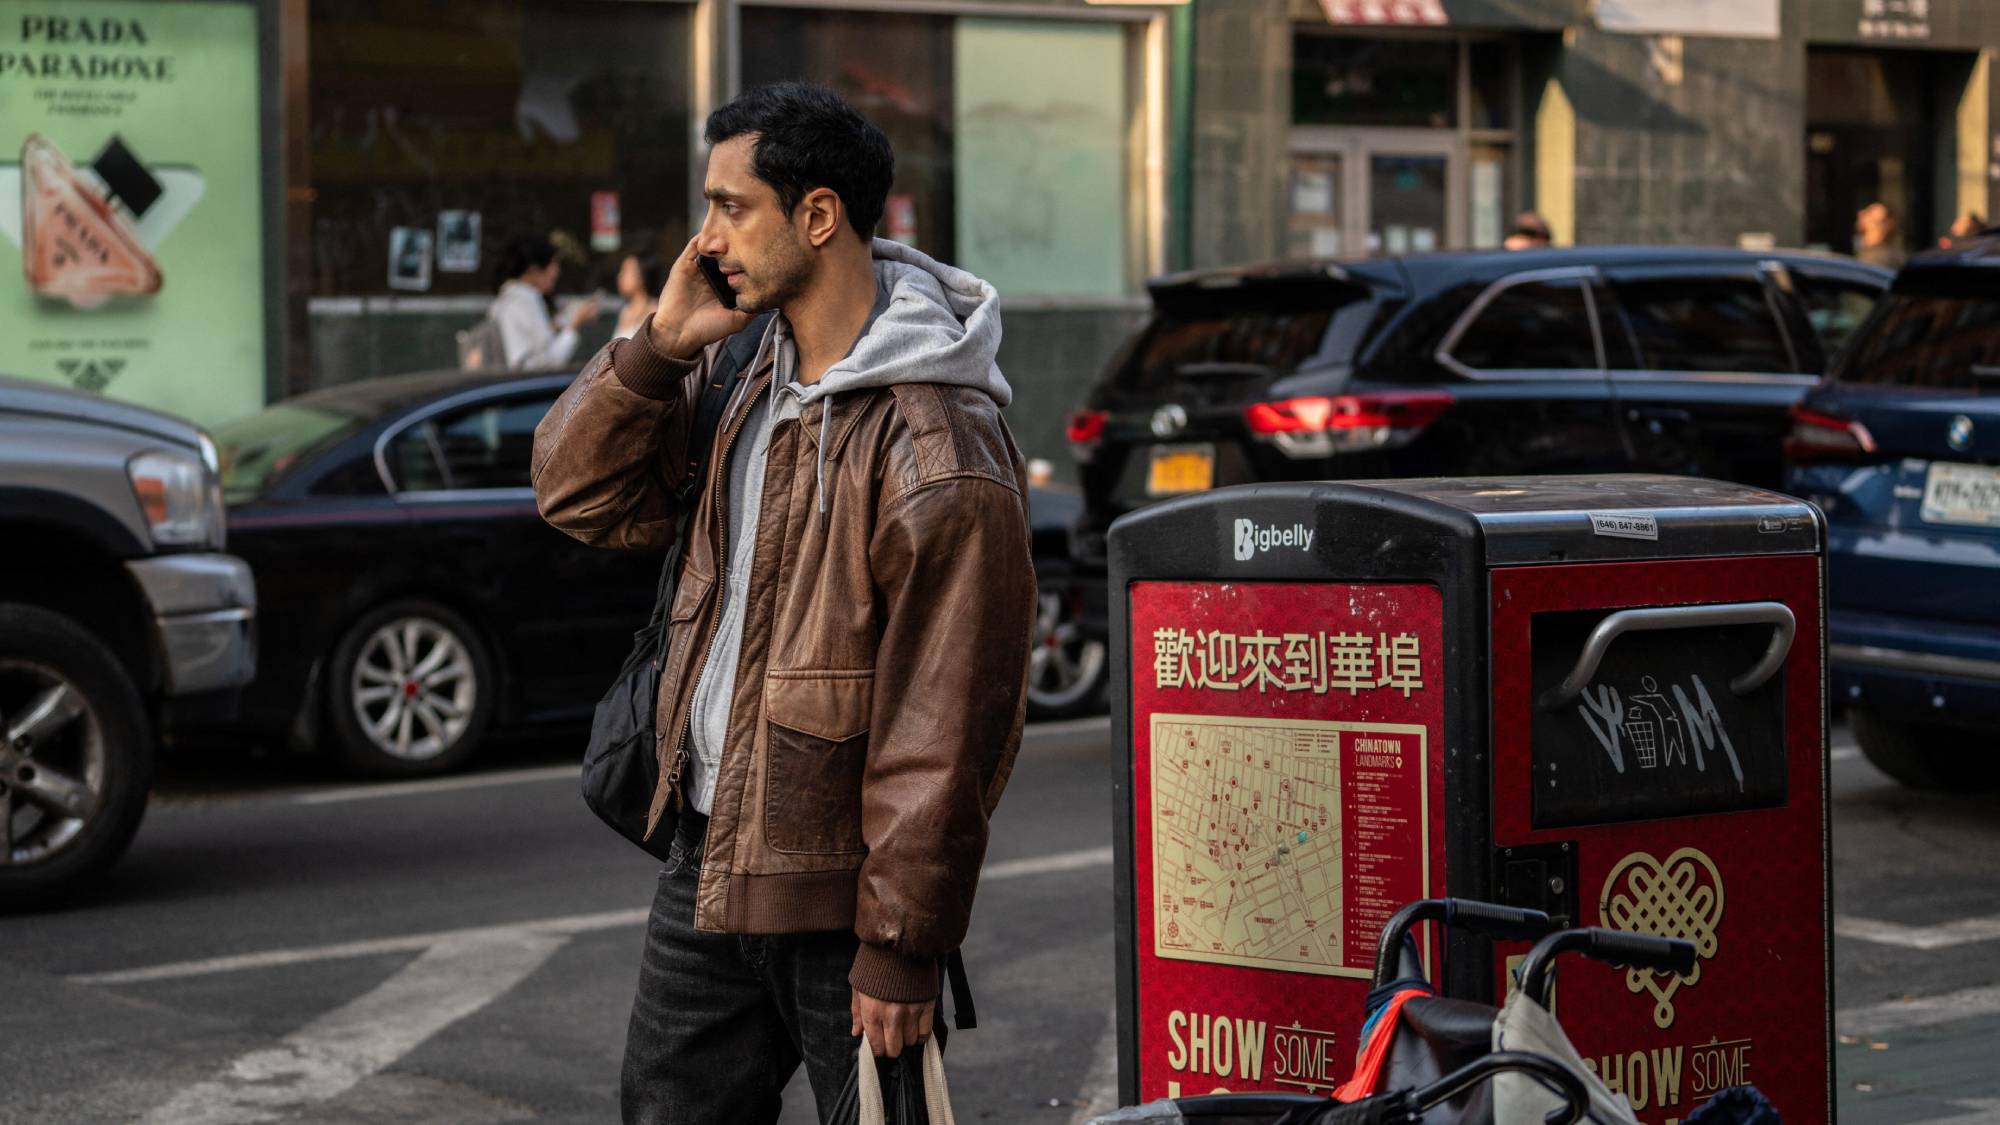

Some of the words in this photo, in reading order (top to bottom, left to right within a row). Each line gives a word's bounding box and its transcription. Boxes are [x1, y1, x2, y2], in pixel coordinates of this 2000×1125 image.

[20, 15, 149, 46] PRADA
[0, 53, 177, 82] PARADOXE
[1235, 518, 1313, 560] Bigbelly
[1153, 627, 1423, 698] 歡迎來到華埠
[1355, 738, 1401, 754] CHINATOWN
[1355, 754, 1395, 768] LANDMARKS
[1168, 1010, 1266, 1081] SHOW
[1274, 1033, 1335, 1081] SOME
[1692, 1046, 1752, 1092] SOME
